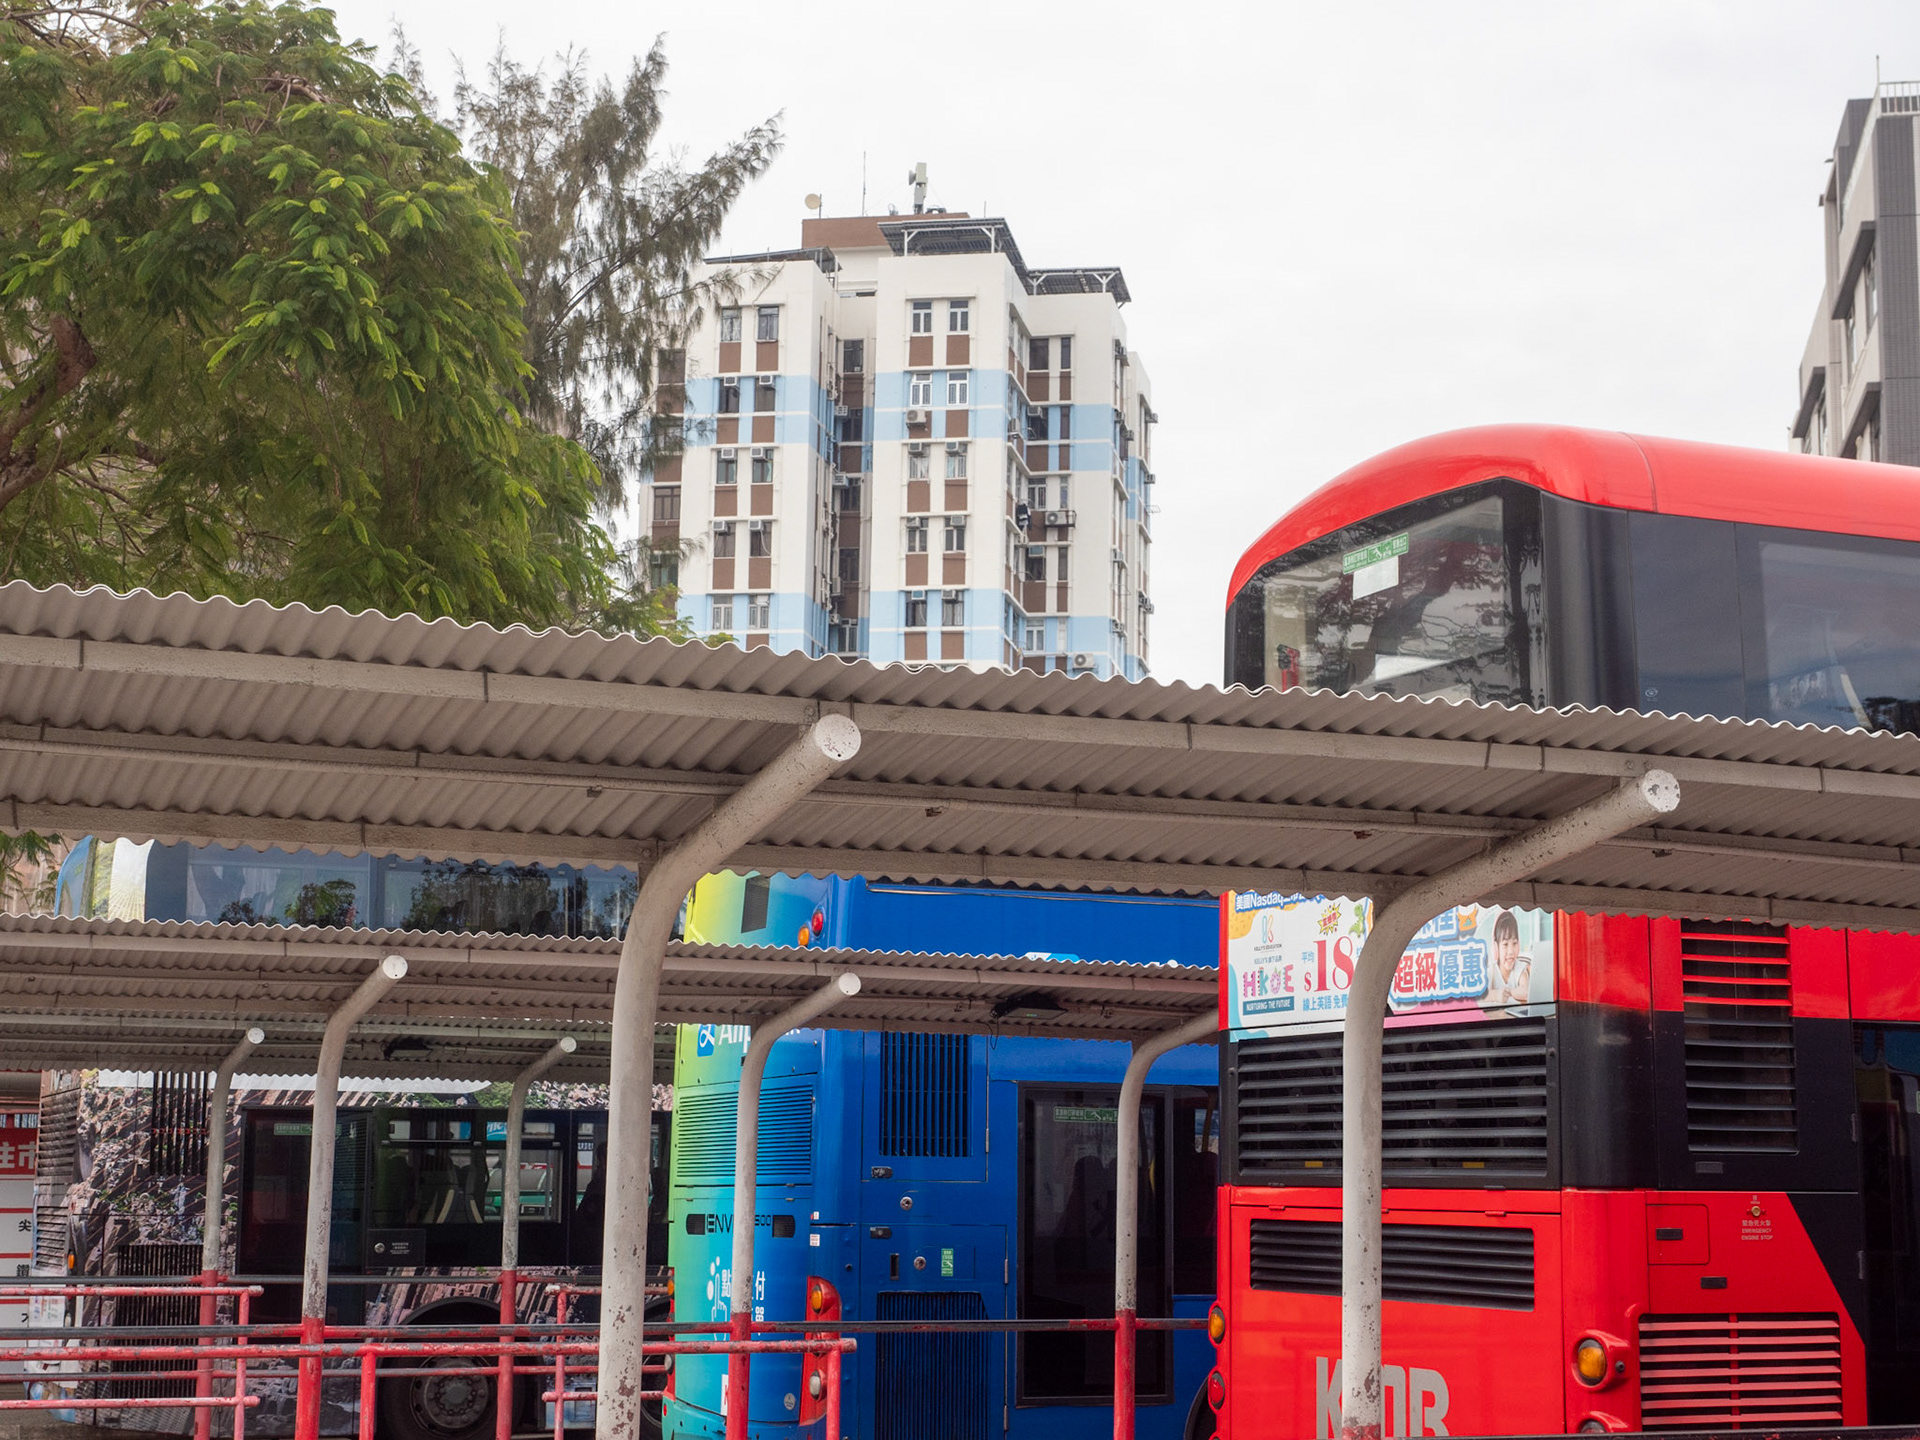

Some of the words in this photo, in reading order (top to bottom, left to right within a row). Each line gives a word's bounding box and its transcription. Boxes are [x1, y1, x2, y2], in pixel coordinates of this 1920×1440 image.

[1394, 946, 1483, 994] 超級優惠
[1246, 1001, 1268, 1012] NURTURING
[1276, 999, 1291, 1009] FUTURE
